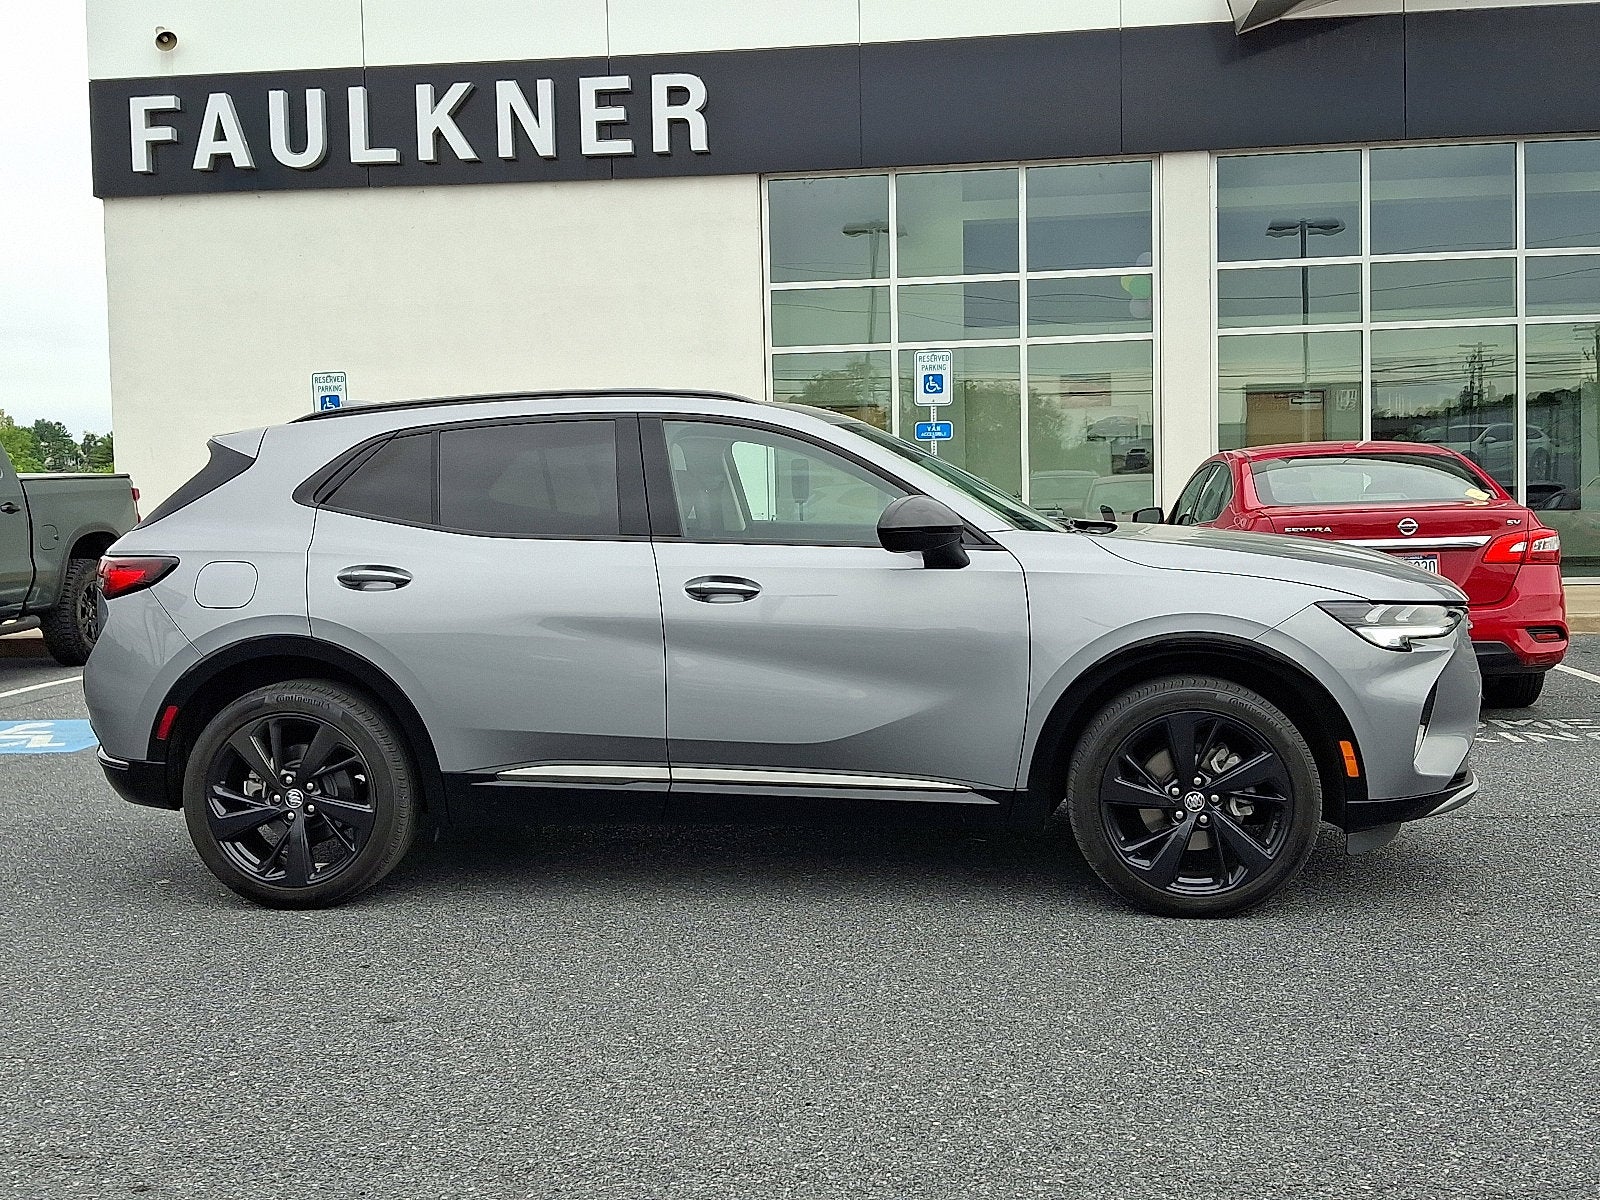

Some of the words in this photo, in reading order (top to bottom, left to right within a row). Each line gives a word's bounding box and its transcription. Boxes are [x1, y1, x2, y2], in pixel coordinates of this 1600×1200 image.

[129, 72, 711, 175] FAULKNER
[918, 354, 950, 362] RESERVED
[314, 375, 344, 383] RESERVED
[276, 694, 326, 707] Continental
